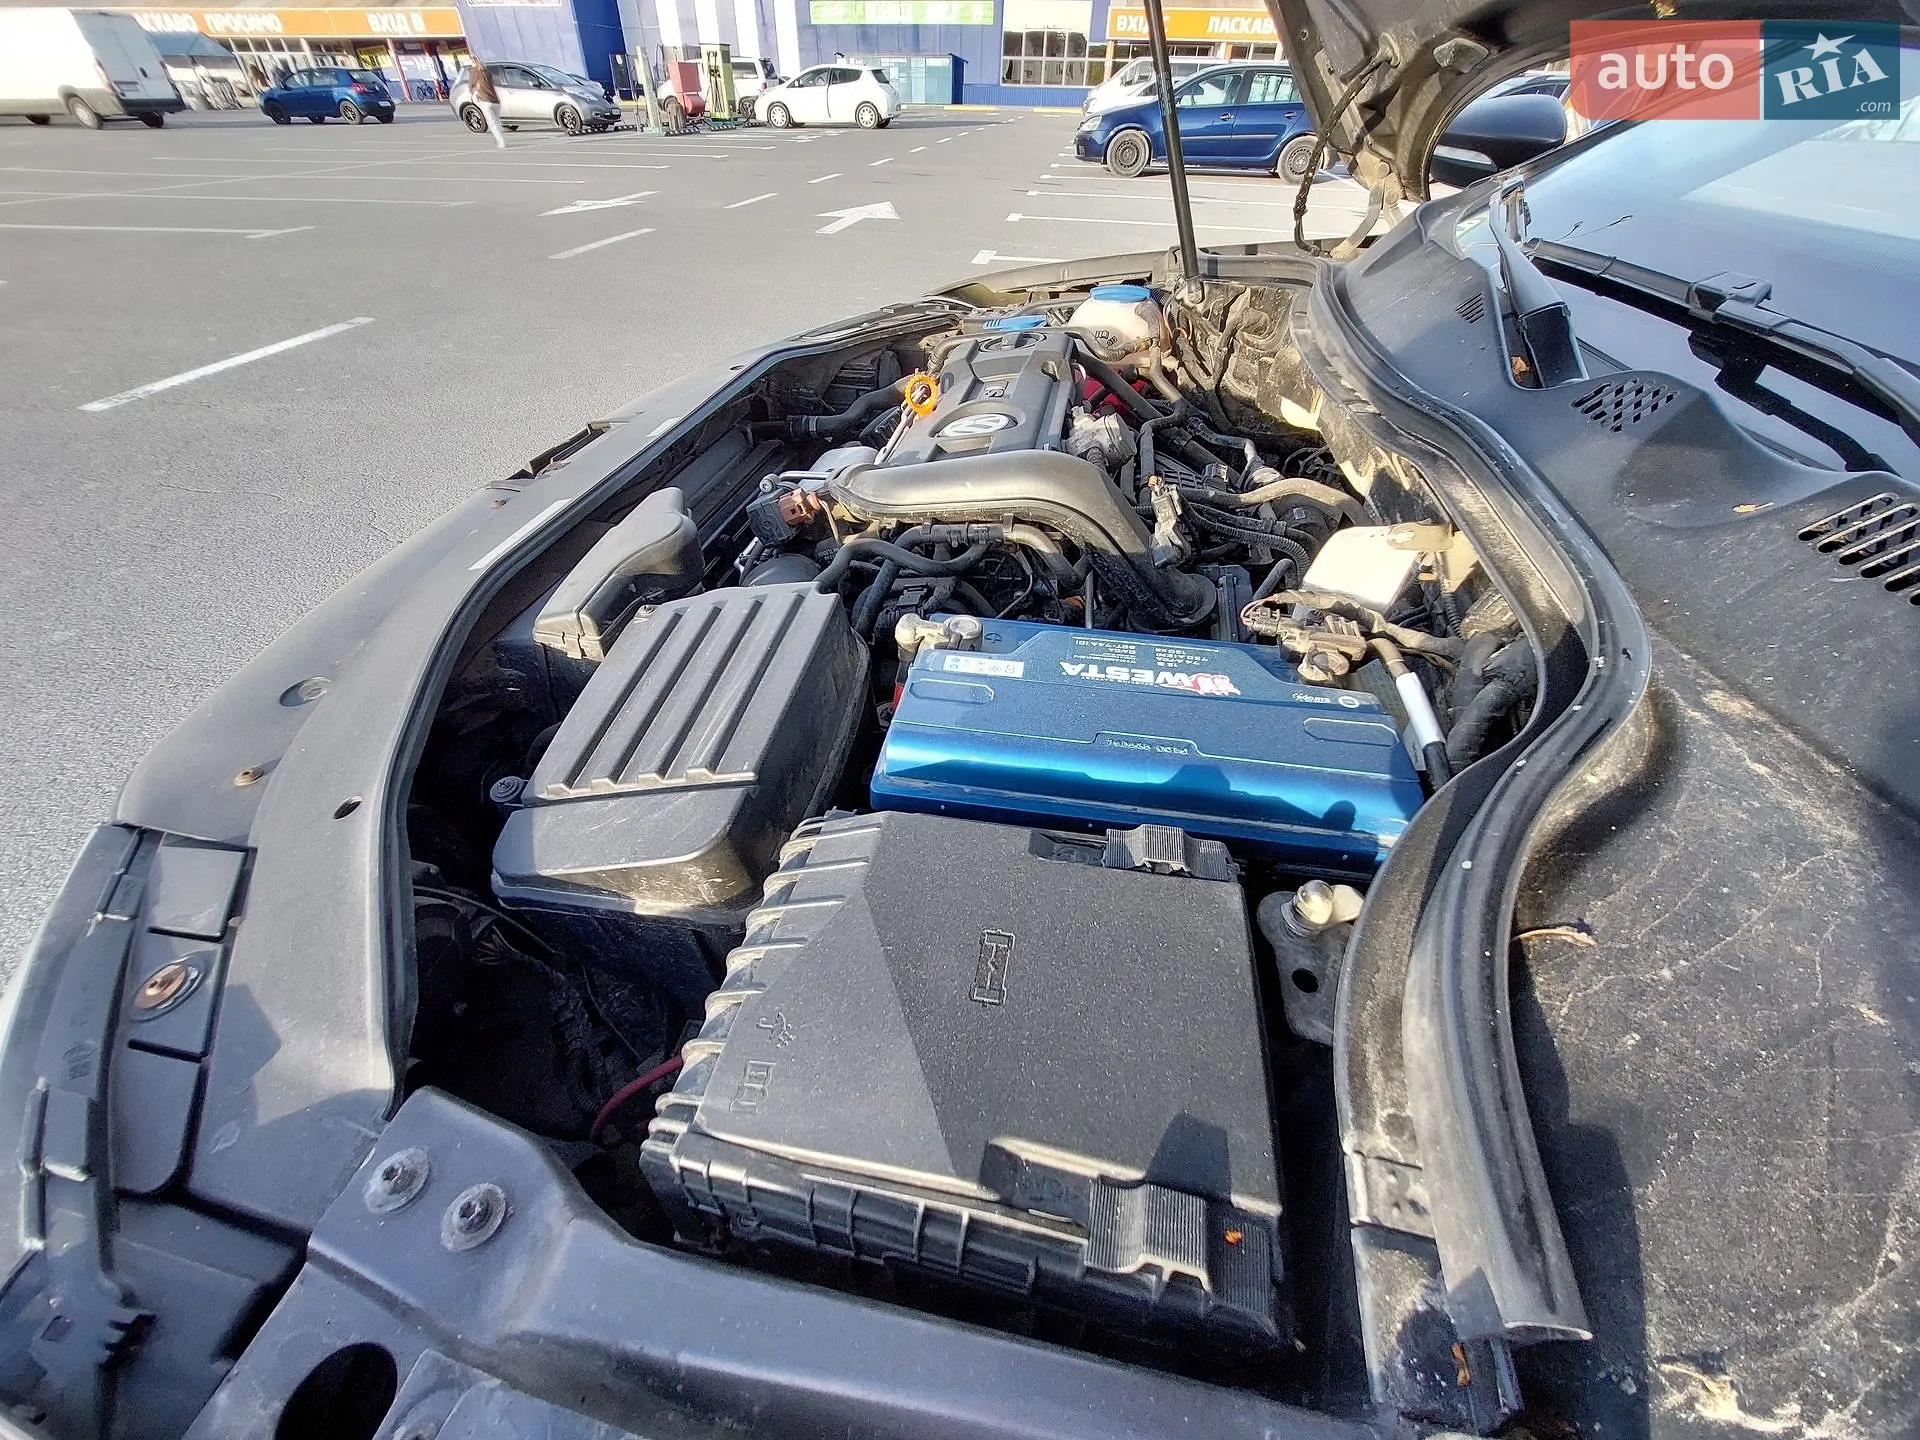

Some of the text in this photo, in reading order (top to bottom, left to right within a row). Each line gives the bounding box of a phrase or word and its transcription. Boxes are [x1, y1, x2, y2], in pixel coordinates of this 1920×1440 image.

[131, 12, 284, 33] АСКАВО ПРОСИМО
[366, 13, 413, 35] ВХІД
[1206, 16, 1277, 35] ЛАСКАВ
[1059, 661, 1189, 686] WESTA
